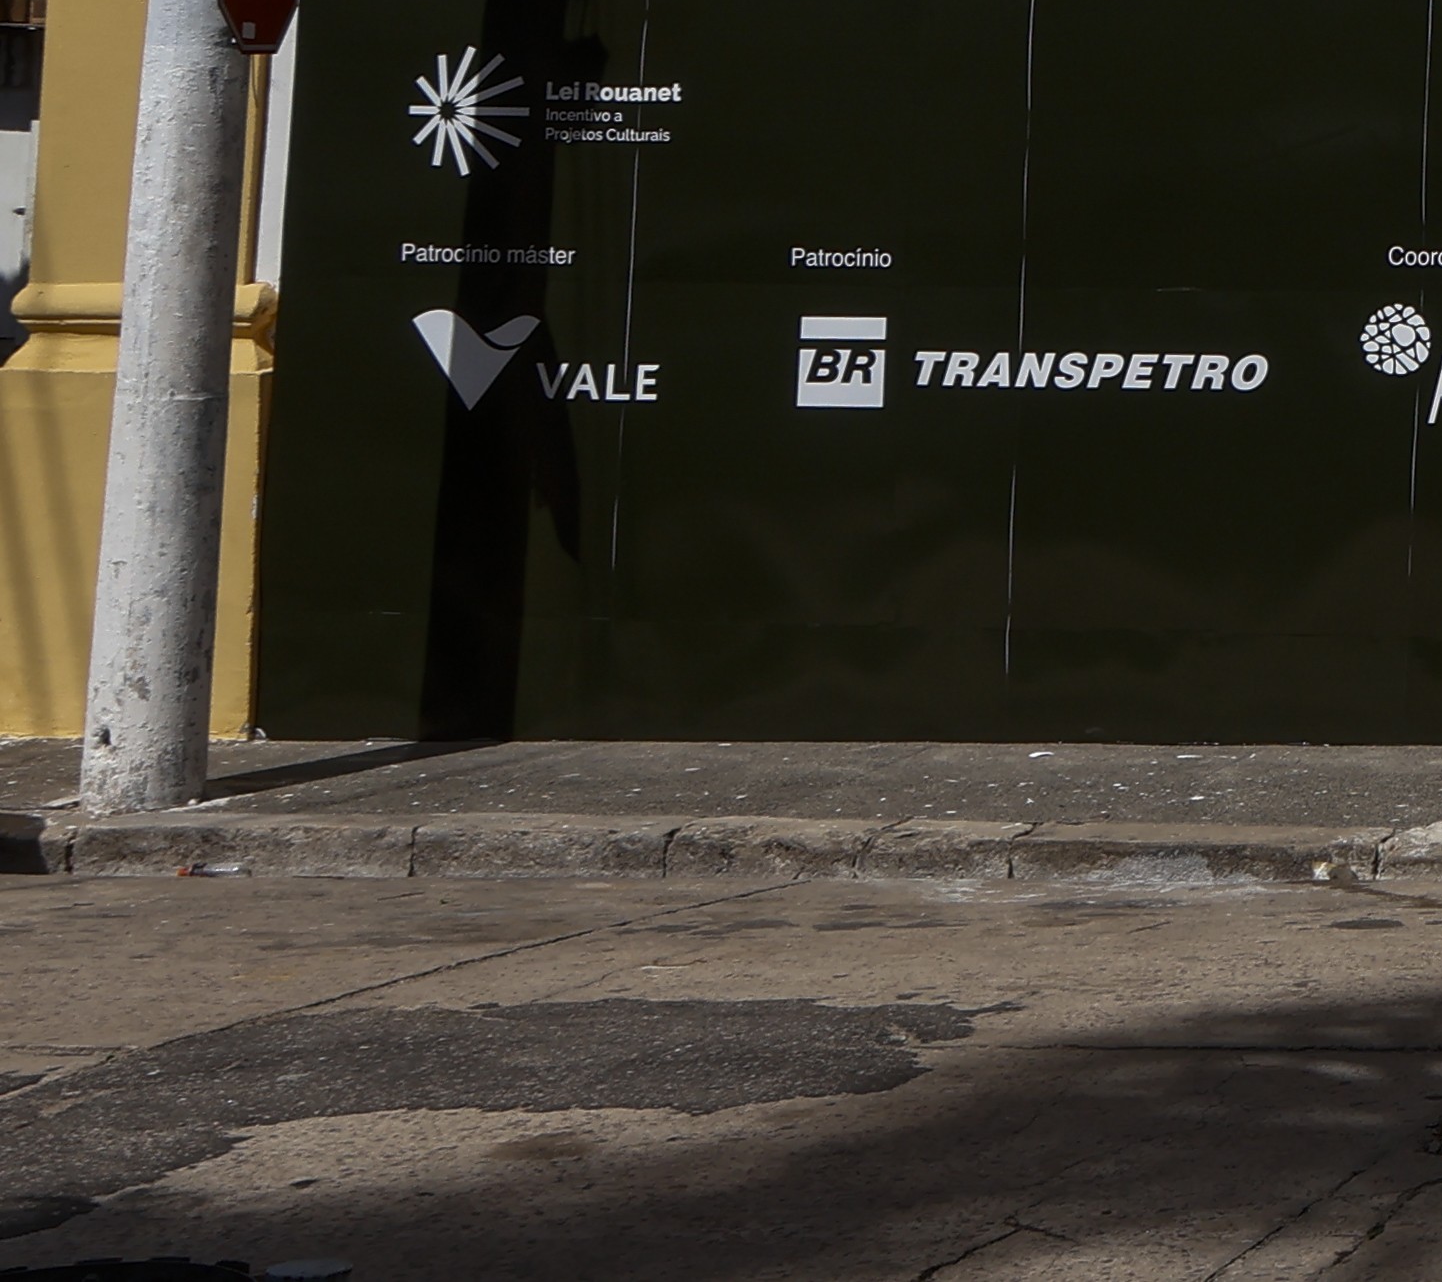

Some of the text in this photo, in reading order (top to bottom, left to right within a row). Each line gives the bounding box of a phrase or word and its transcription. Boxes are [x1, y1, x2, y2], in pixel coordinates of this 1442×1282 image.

[546, 80, 682, 103] Lei Rouanet
[545, 108, 624, 123] Incentivo a
[545, 126, 672, 144] Projetos Culturais
[400, 242, 577, 266] Patrocínio máster
[791, 247, 892, 268] Patrocínio
[803, 348, 1269, 391] BR TRANSPETRO
[536, 363, 661, 402] VALE
